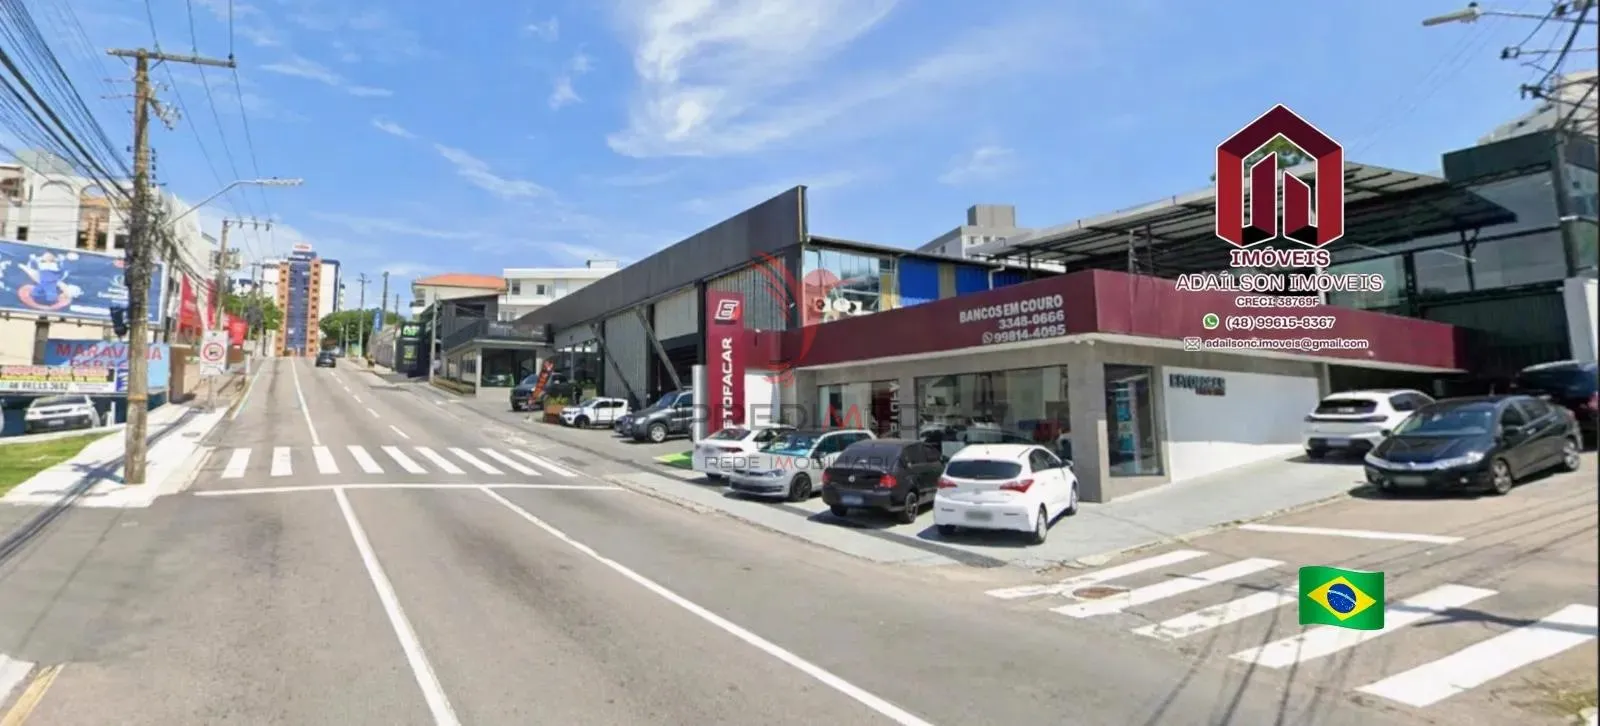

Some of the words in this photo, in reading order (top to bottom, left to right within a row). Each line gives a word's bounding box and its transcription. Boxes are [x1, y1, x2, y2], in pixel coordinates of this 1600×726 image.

[960, 305, 1002, 322] BANCOS
[1004, 302, 1019, 316] EM
[1020, 294, 1063, 312] COURO
[999, 310, 1065, 329] 3348-0666
[994, 324, 1066, 342] 99814-4095
[722, 337, 733, 429] STOFACAR
